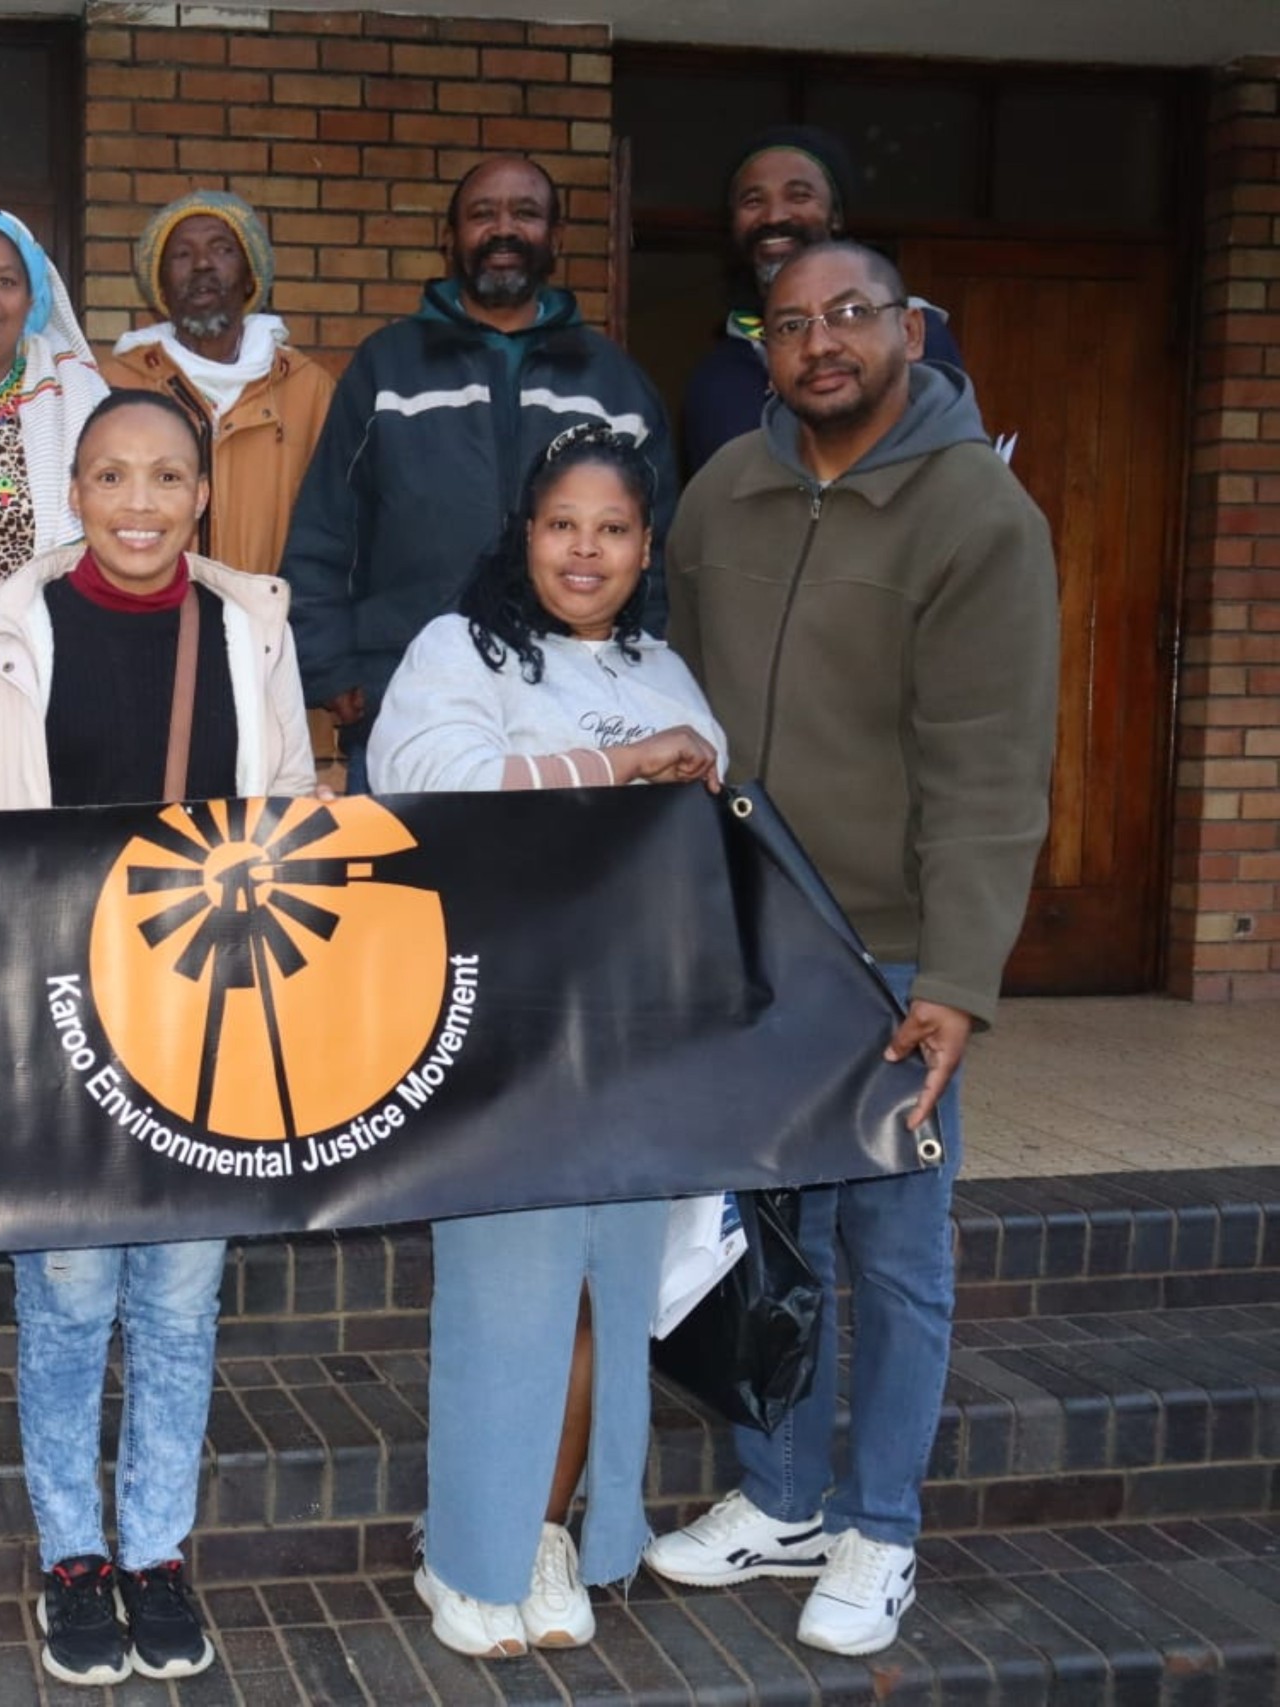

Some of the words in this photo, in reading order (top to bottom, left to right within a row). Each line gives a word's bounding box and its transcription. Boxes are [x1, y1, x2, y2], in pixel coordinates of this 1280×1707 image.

[46, 974, 96, 1071] Karoo
[84, 1066, 293, 1178] Environmental
[302, 1104, 405, 1172] Justice
[396, 954, 479, 1109] Movement
